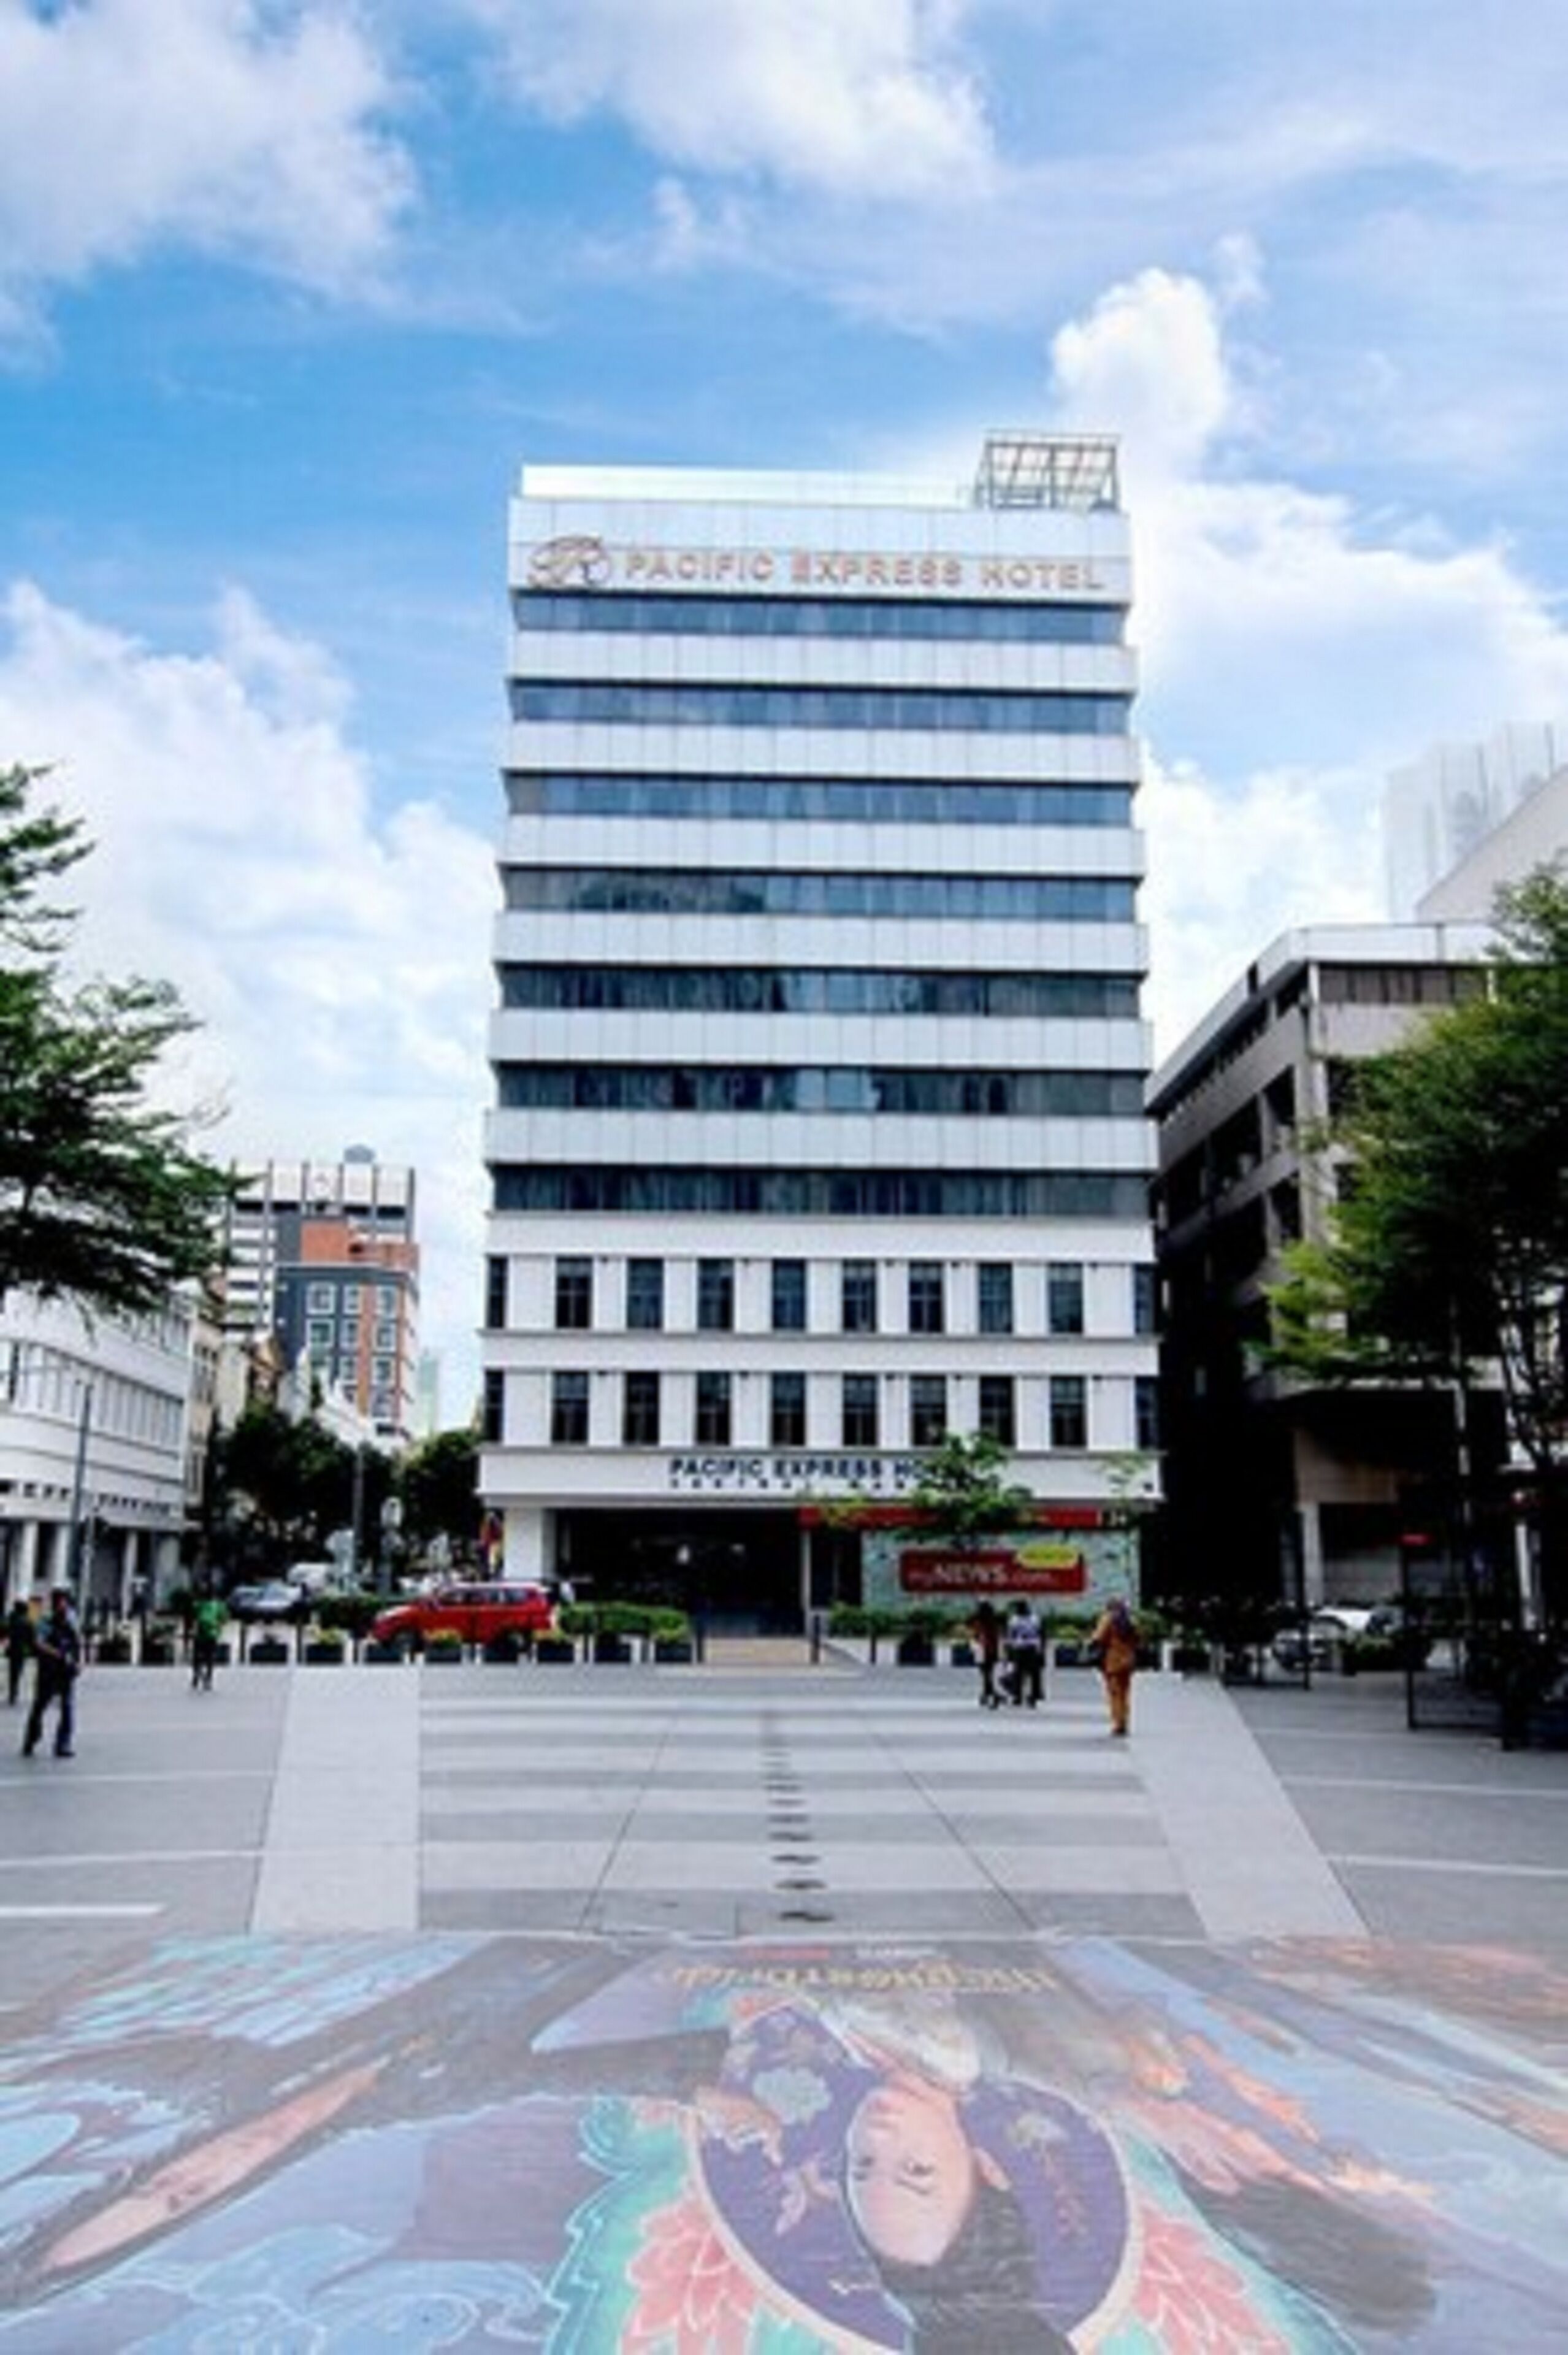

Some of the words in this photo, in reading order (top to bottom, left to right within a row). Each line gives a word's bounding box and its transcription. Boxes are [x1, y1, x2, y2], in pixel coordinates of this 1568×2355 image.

[625, 552, 775, 583] PACIFIC
[790, 553, 963, 587] EXPRESS
[981, 562, 1106, 591] HOTEL
[671, 1457, 765, 1477] PACIFIC
[774, 1458, 883, 1478] EXPRESS
